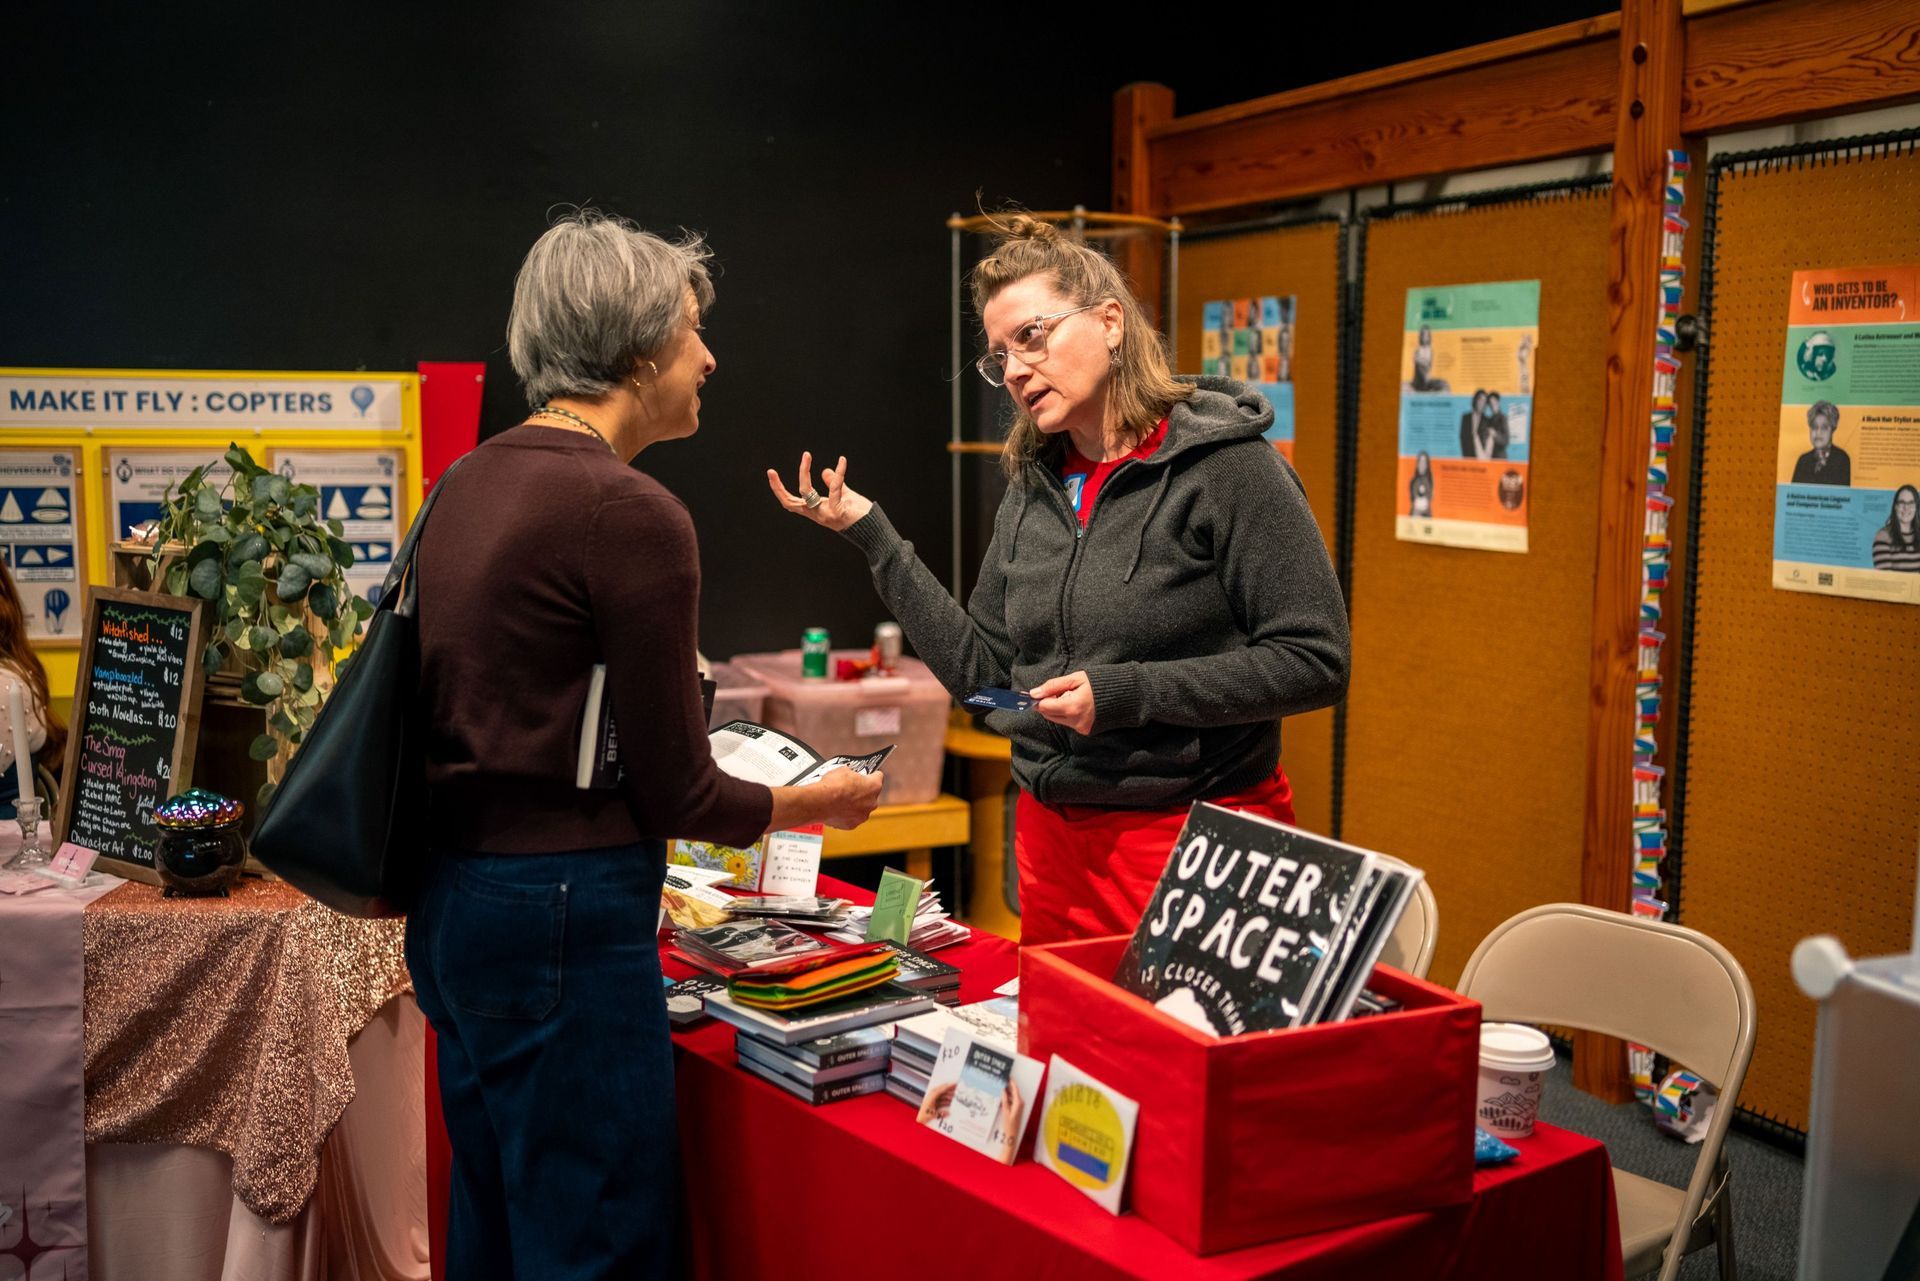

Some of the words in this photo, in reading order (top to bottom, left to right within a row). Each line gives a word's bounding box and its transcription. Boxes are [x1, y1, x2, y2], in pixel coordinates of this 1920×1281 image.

[1813, 284, 1834, 295] WHO
[1836, 282, 1859, 294] GETS
[1862, 281, 1874, 293] TO
[1876, 280, 1888, 292] BE
[1812, 297, 1828, 311] AN
[1831, 293, 1898, 311] INVENTOR?
[10, 389, 96, 412] MAKE
[104, 390, 128, 412] IT
[136, 391, 184, 413] FLY
[205, 391, 333, 414] COPTERS
[170, 624, 184, 641] $12
[163, 666, 179, 686] $12
[90, 701, 110, 718] Both
[158, 710, 176, 729] $20
[84, 735, 102, 753] The
[81, 753, 113, 780] Cursed
[116, 763, 157, 799] Kingdom
[70, 829, 111, 852] Character
[111, 840, 125, 856] Art
[132, 844, 153, 861] $2.00
[1177, 835, 1322, 918] OUTER
[1150, 888, 1300, 984] SPACE
[684, 980, 725, 990] OUT
[1141, 964, 1155, 984] IS
[1164, 962, 1221, 998] CLOSER
[1217, 991, 1246, 1036] THAN
[837, 1051, 856, 1062] OUTER
[942, 1045, 960, 1062] $20
[831, 1086, 851, 1098] OUTER
